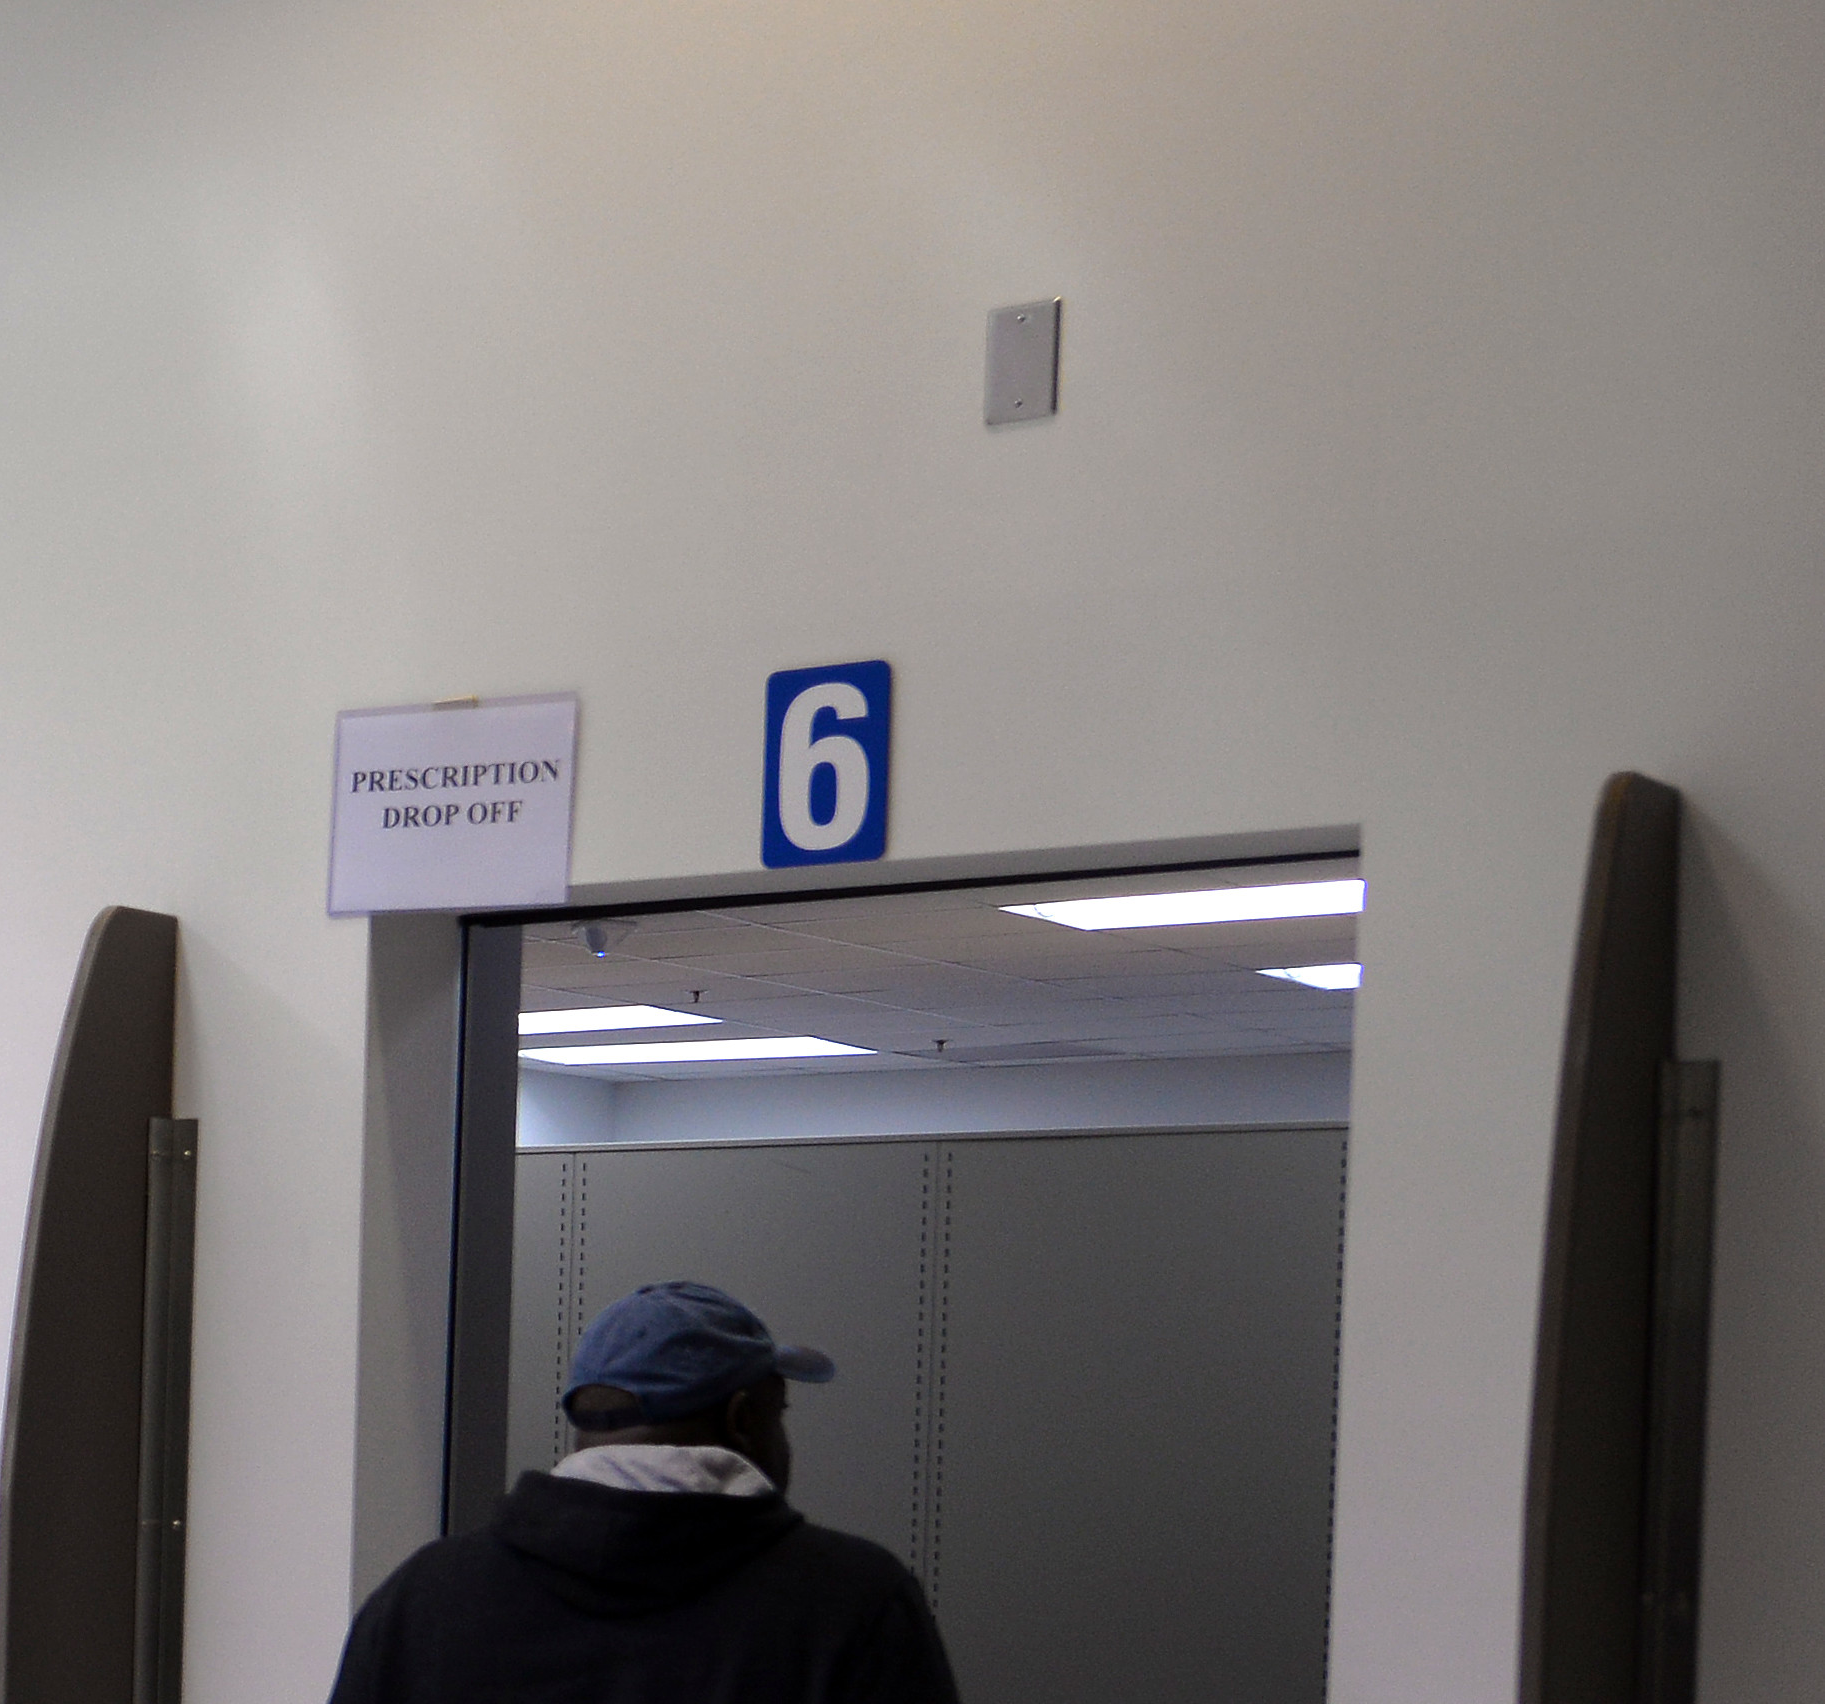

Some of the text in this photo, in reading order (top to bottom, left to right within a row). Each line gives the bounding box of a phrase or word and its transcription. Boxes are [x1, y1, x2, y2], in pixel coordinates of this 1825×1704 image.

[351, 760, 559, 793] PRESCRIPTION
[778, 683, 870, 851] 6
[382, 801, 522, 829] DROP OFF
